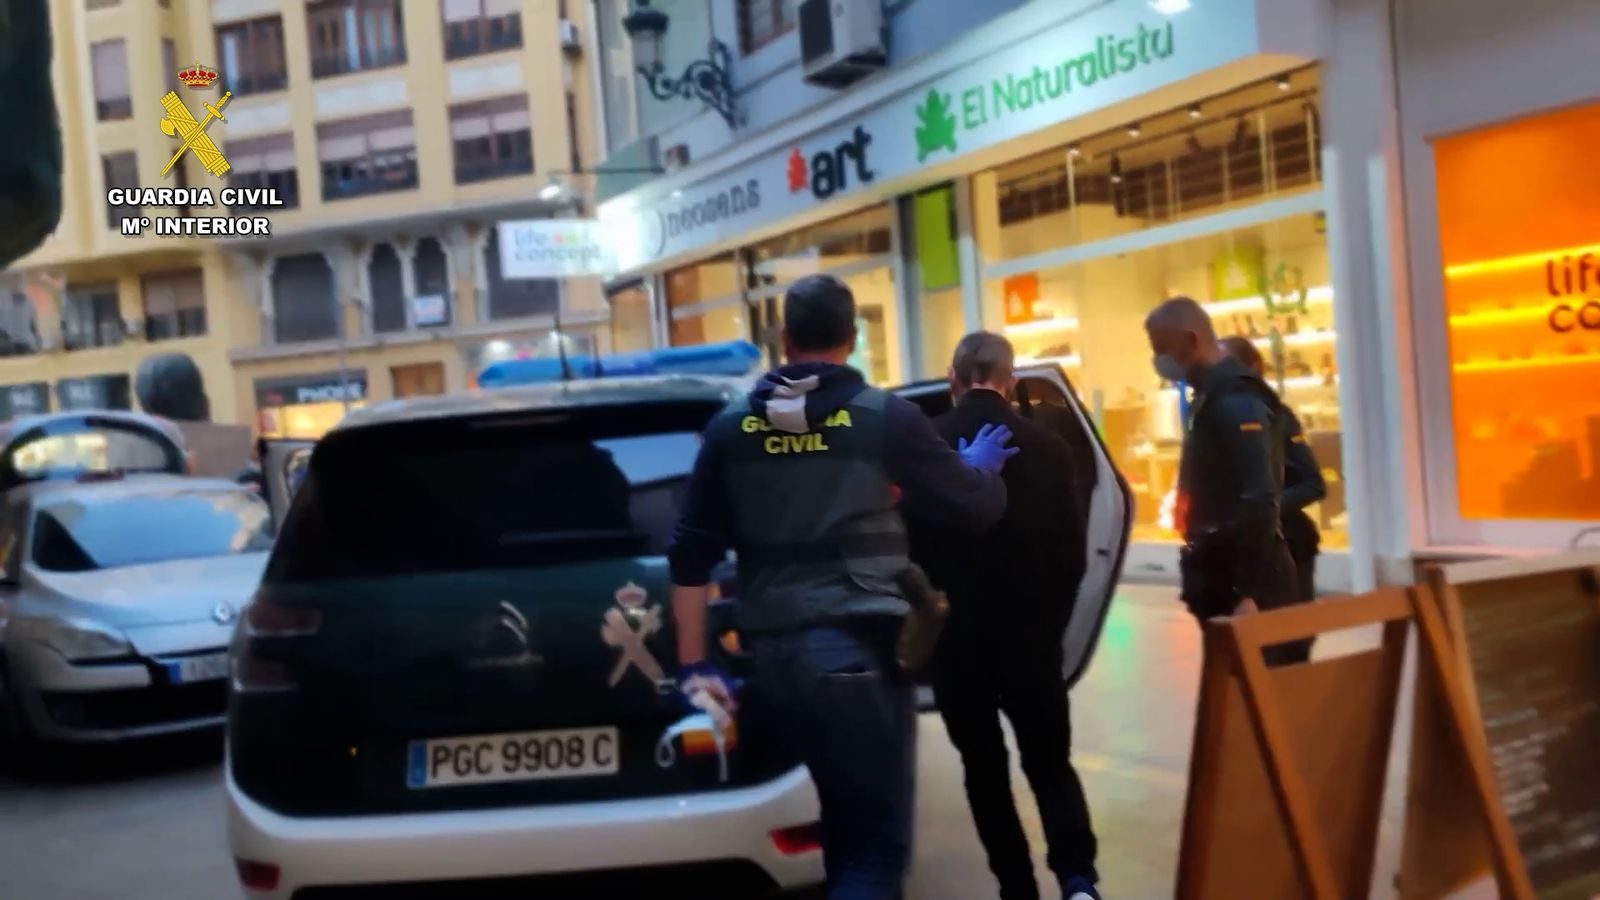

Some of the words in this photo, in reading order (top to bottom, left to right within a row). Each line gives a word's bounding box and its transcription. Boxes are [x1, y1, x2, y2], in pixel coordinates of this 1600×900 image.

[961, 84, 989, 131] El
[993, 23, 1174, 114] Naturalista
[810, 125, 873, 199] art
[764, 433, 829, 454] CIVIL
[429, 744, 493, 780] PGC
[501, 737, 587, 773] 9908
[592, 733, 613, 767] C
